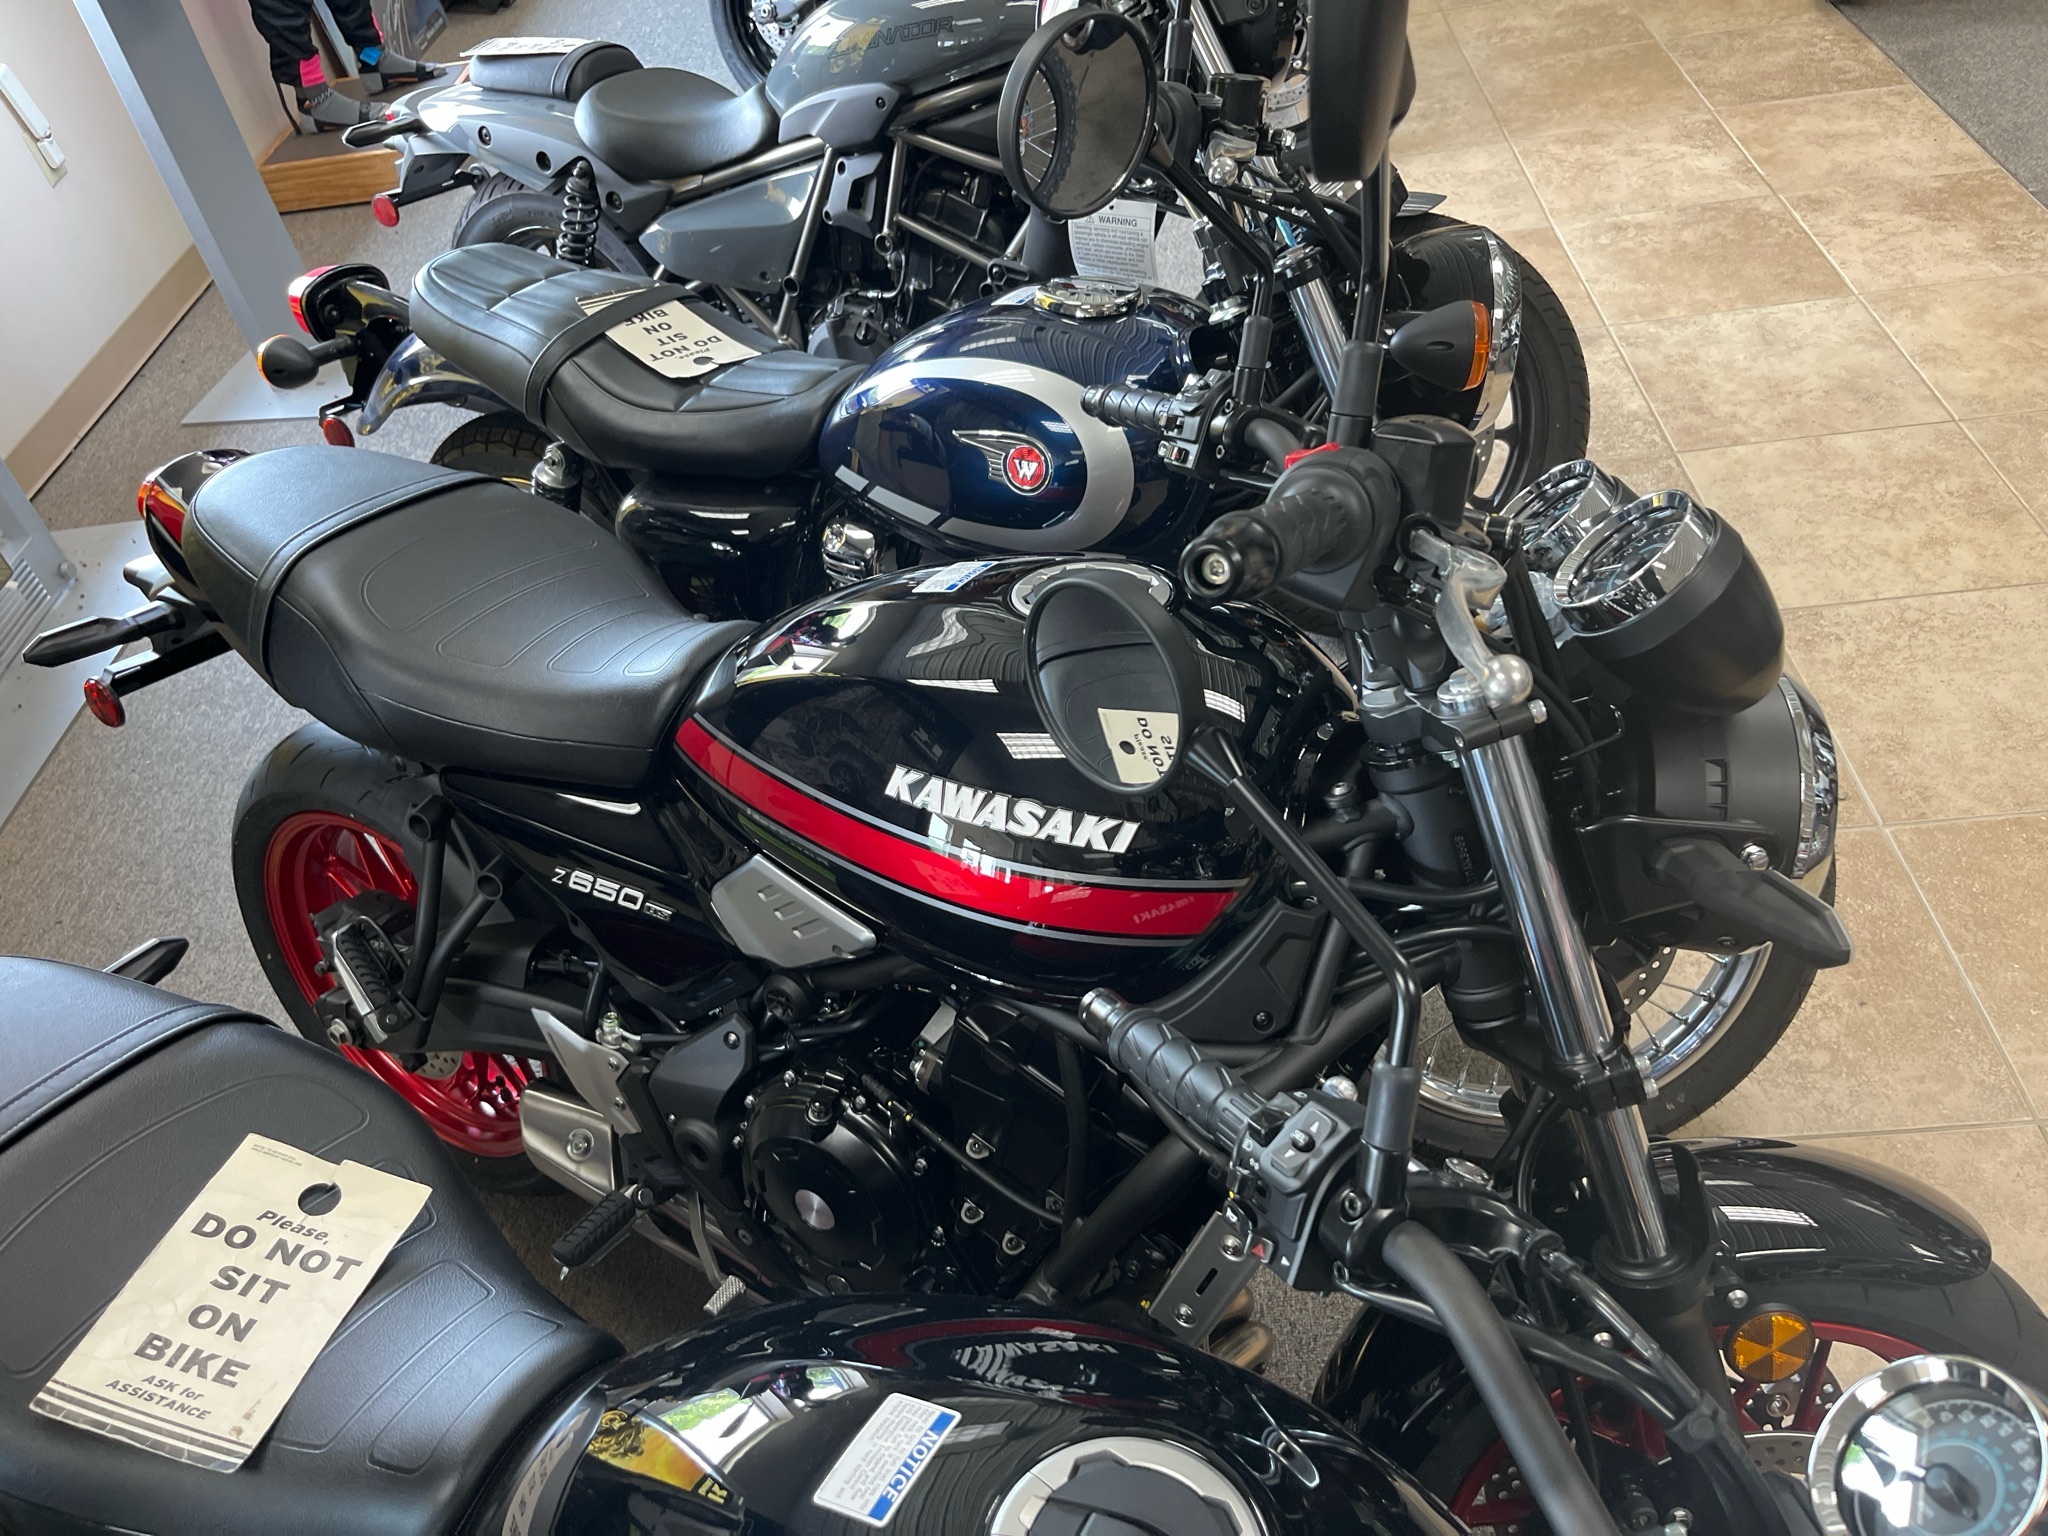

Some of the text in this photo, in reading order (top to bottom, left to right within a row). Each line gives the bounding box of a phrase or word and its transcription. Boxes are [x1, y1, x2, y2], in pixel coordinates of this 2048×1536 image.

[1098, 216, 1137, 227] WARNING
[643, 322, 672, 335] ON
[657, 333, 688, 346] SIT
[650, 335, 722, 362] DO NOT
[675, 348, 710, 360] Please,
[1013, 458, 1039, 481] W
[884, 763, 1141, 854] KAWASAKI
[191, 1211, 362, 1280] DO NOT
[257, 1210, 330, 1246] Please,
[210, 1265, 290, 1304] SIT
[188, 1304, 257, 1342] ON
[134, 1332, 250, 1389] BIKE
[105, 1380, 211, 1421] ASSISTANCE
[141, 1374, 204, 1401] ASK for
[883, 1430, 939, 1502] NOTICE
